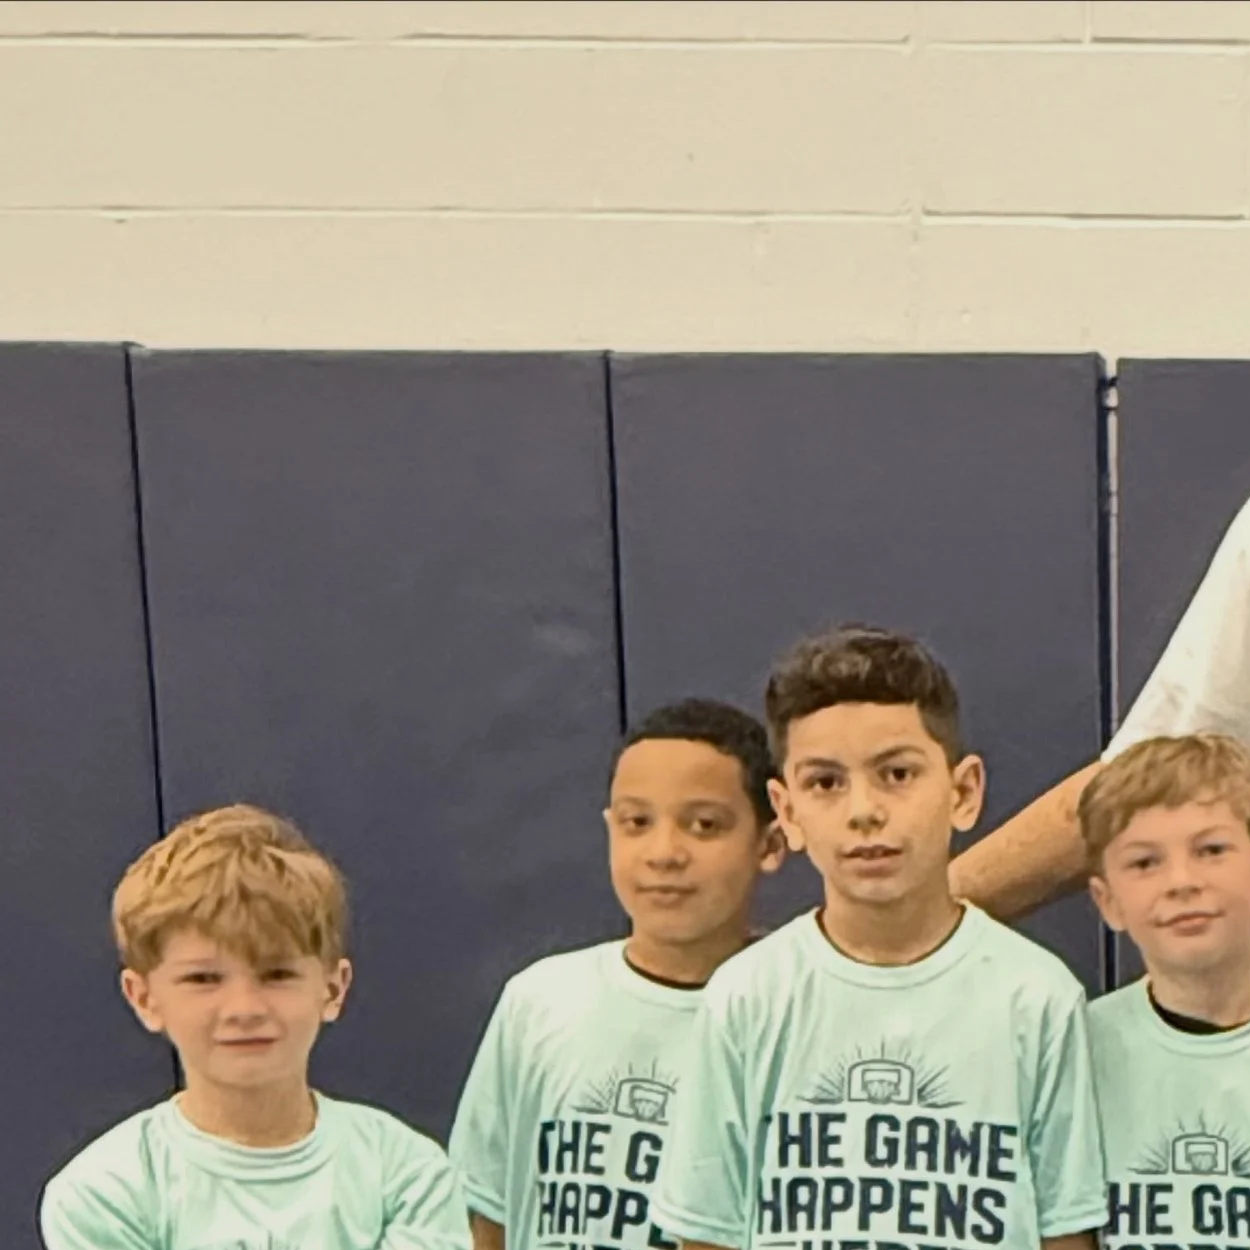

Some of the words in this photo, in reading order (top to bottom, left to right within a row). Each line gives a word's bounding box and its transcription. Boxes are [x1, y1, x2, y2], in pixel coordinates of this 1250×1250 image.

[764, 1111, 847, 1168] HE
[864, 1113, 1017, 1182] GAME
[757, 1176, 1006, 1245] HAPPENS
[1104, 1182, 1174, 1236] HE
